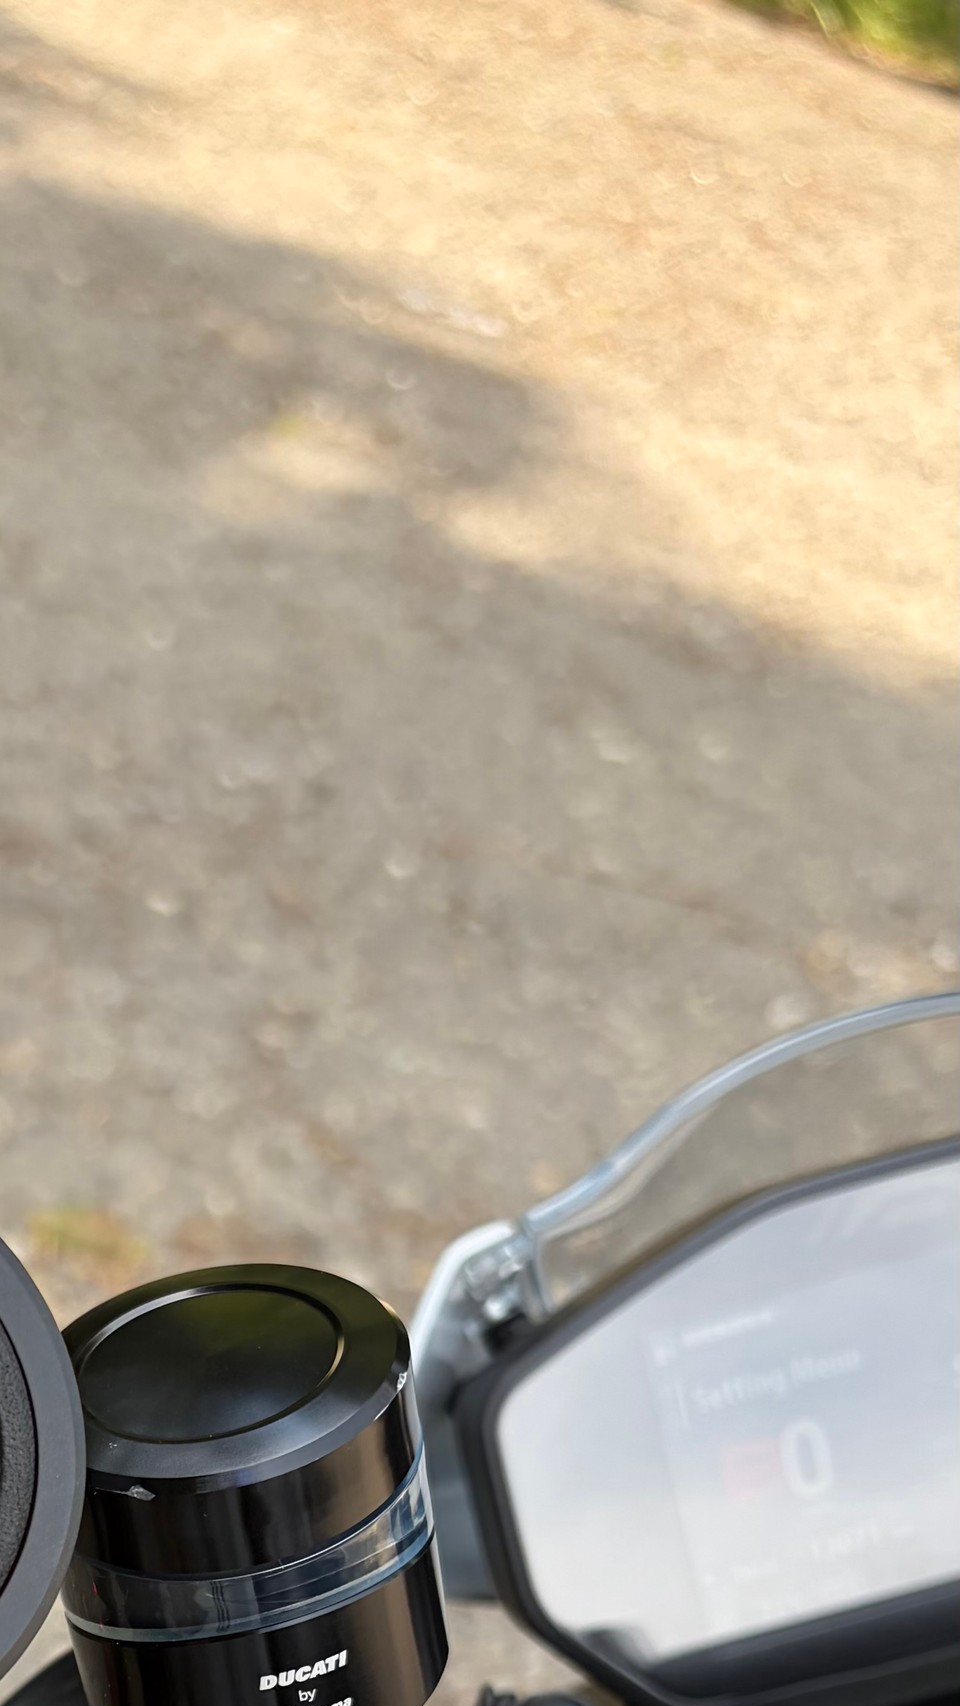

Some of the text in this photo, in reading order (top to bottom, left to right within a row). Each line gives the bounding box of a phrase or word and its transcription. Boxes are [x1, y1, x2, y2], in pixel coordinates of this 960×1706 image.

[780, 1419, 833, 1498] 0
[259, 1649, 347, 1691] DUCATI
[298, 1688, 316, 1702] by
